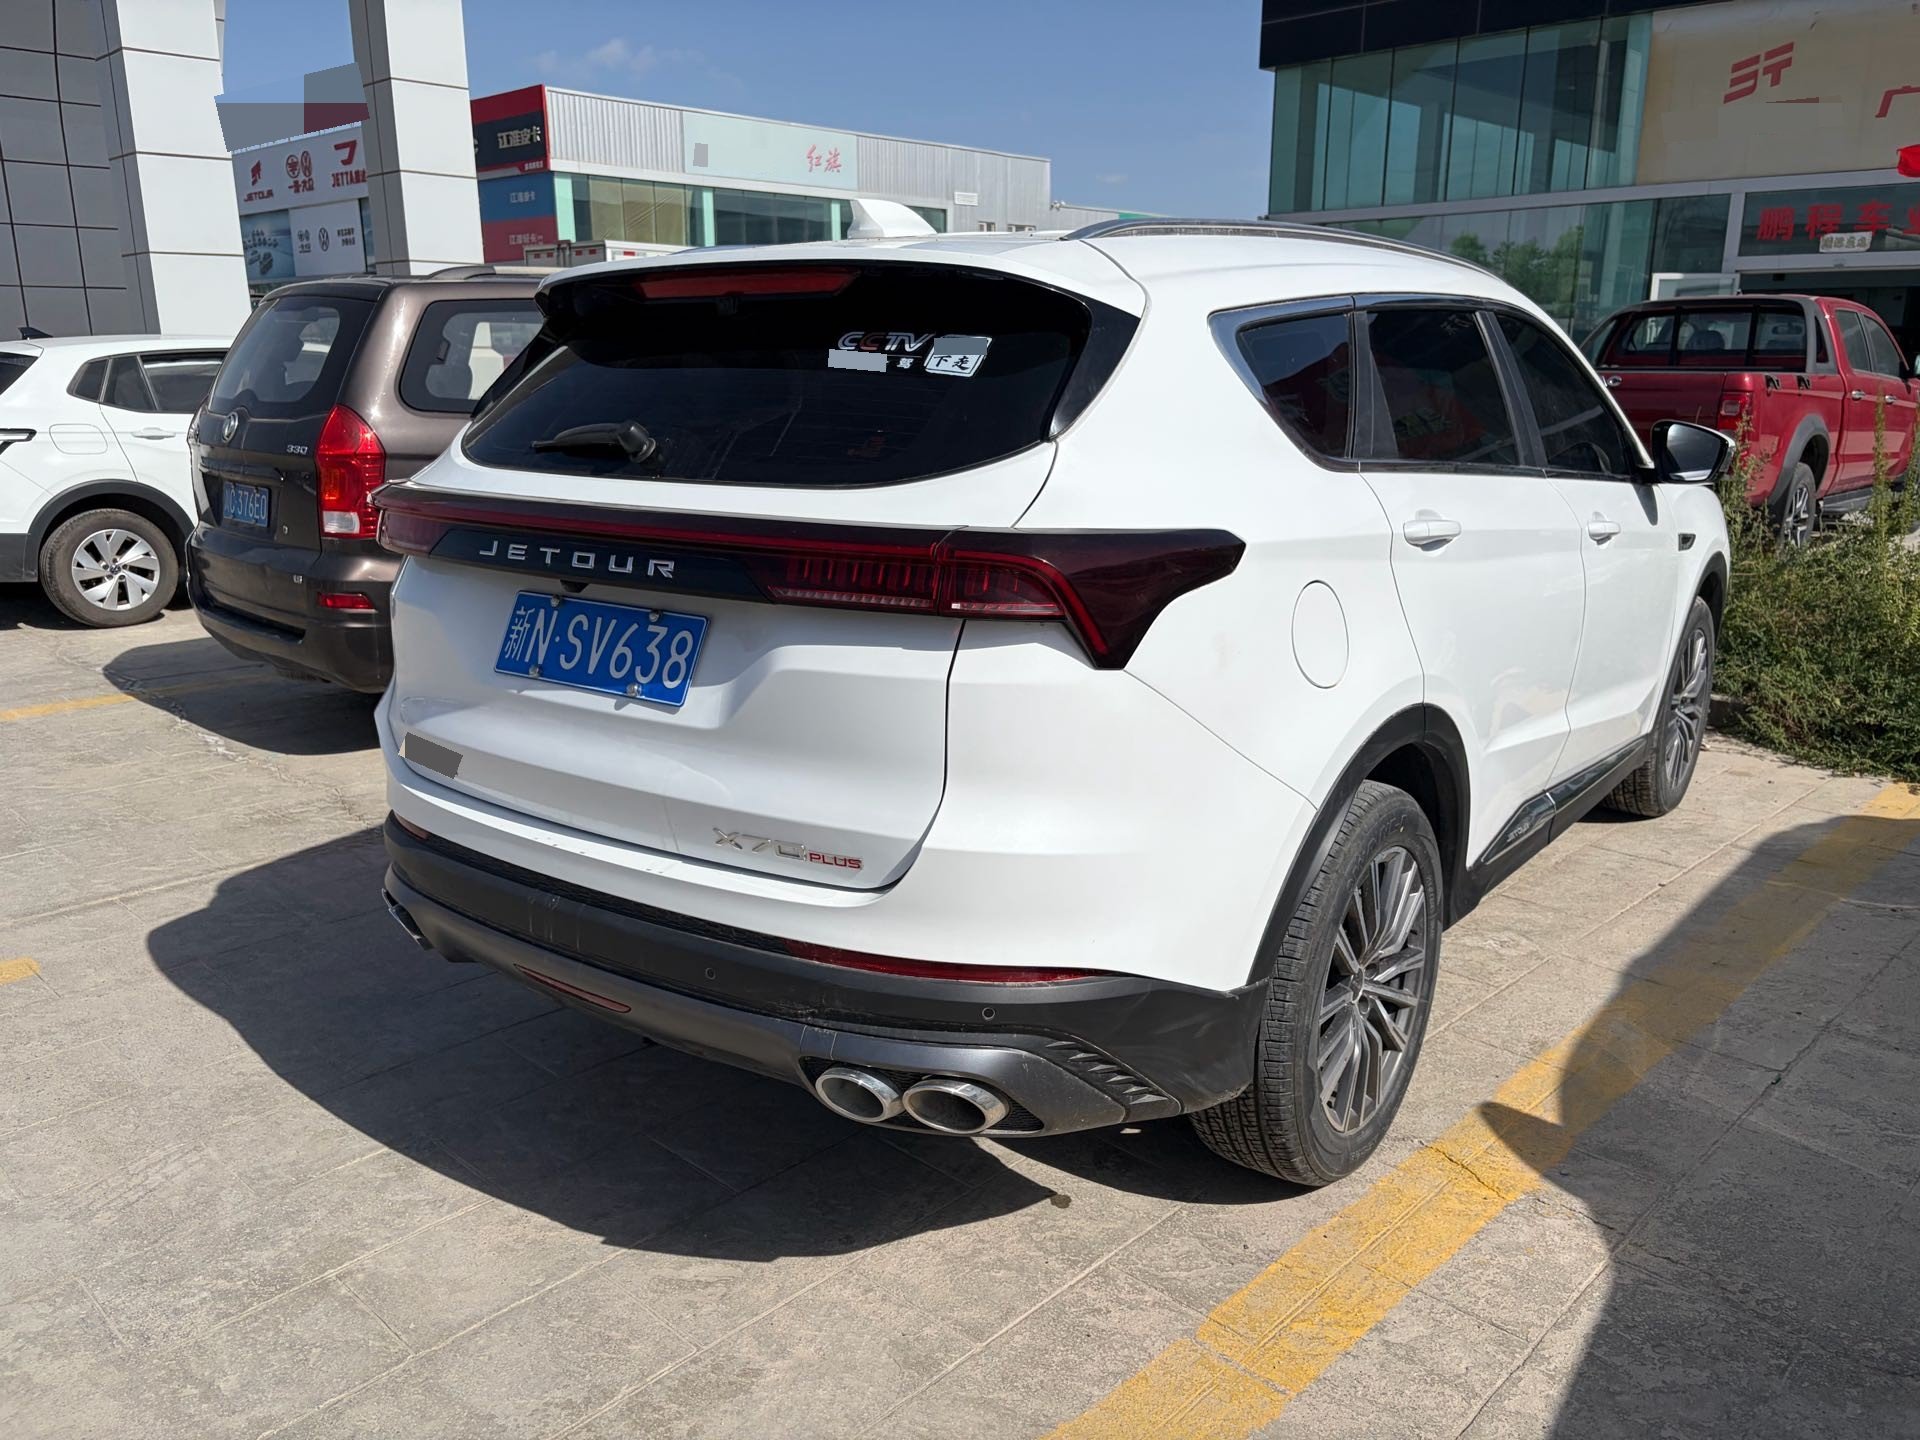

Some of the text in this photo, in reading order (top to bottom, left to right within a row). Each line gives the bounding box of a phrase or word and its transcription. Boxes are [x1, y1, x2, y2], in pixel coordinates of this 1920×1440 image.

[806, 144, 842, 173] 红旗
[286, 444, 308, 455] 330
[479, 540, 675, 578] JETOUR
[712, 827, 864, 870] X70 PLUS
